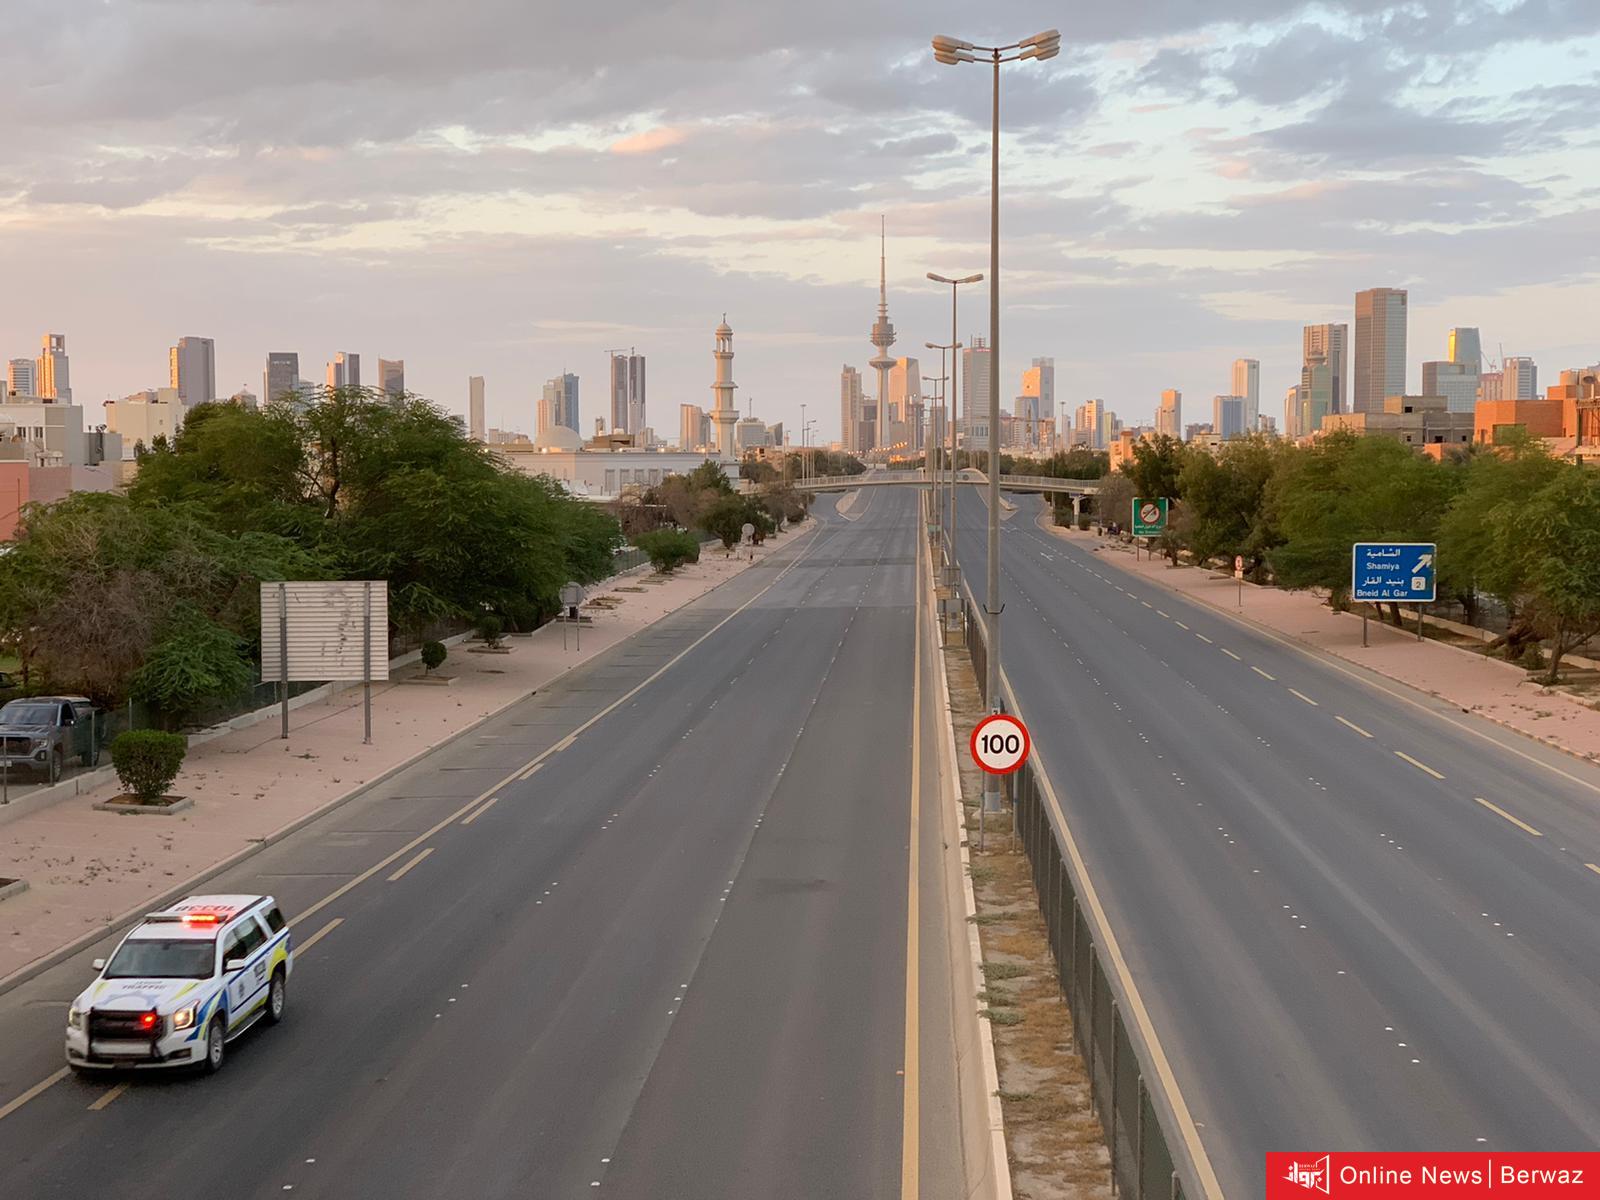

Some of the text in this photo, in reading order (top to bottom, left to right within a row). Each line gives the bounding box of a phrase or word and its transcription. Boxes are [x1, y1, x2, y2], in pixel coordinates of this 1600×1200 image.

[1366, 548, 1400, 558] الشامية
[1366, 562, 1400, 571] Shamiya
[1362, 576, 1404, 587] بنيد القار
[1356, 589, 1408, 597] Bneid Al Gar
[981, 734, 1020, 754] 100
